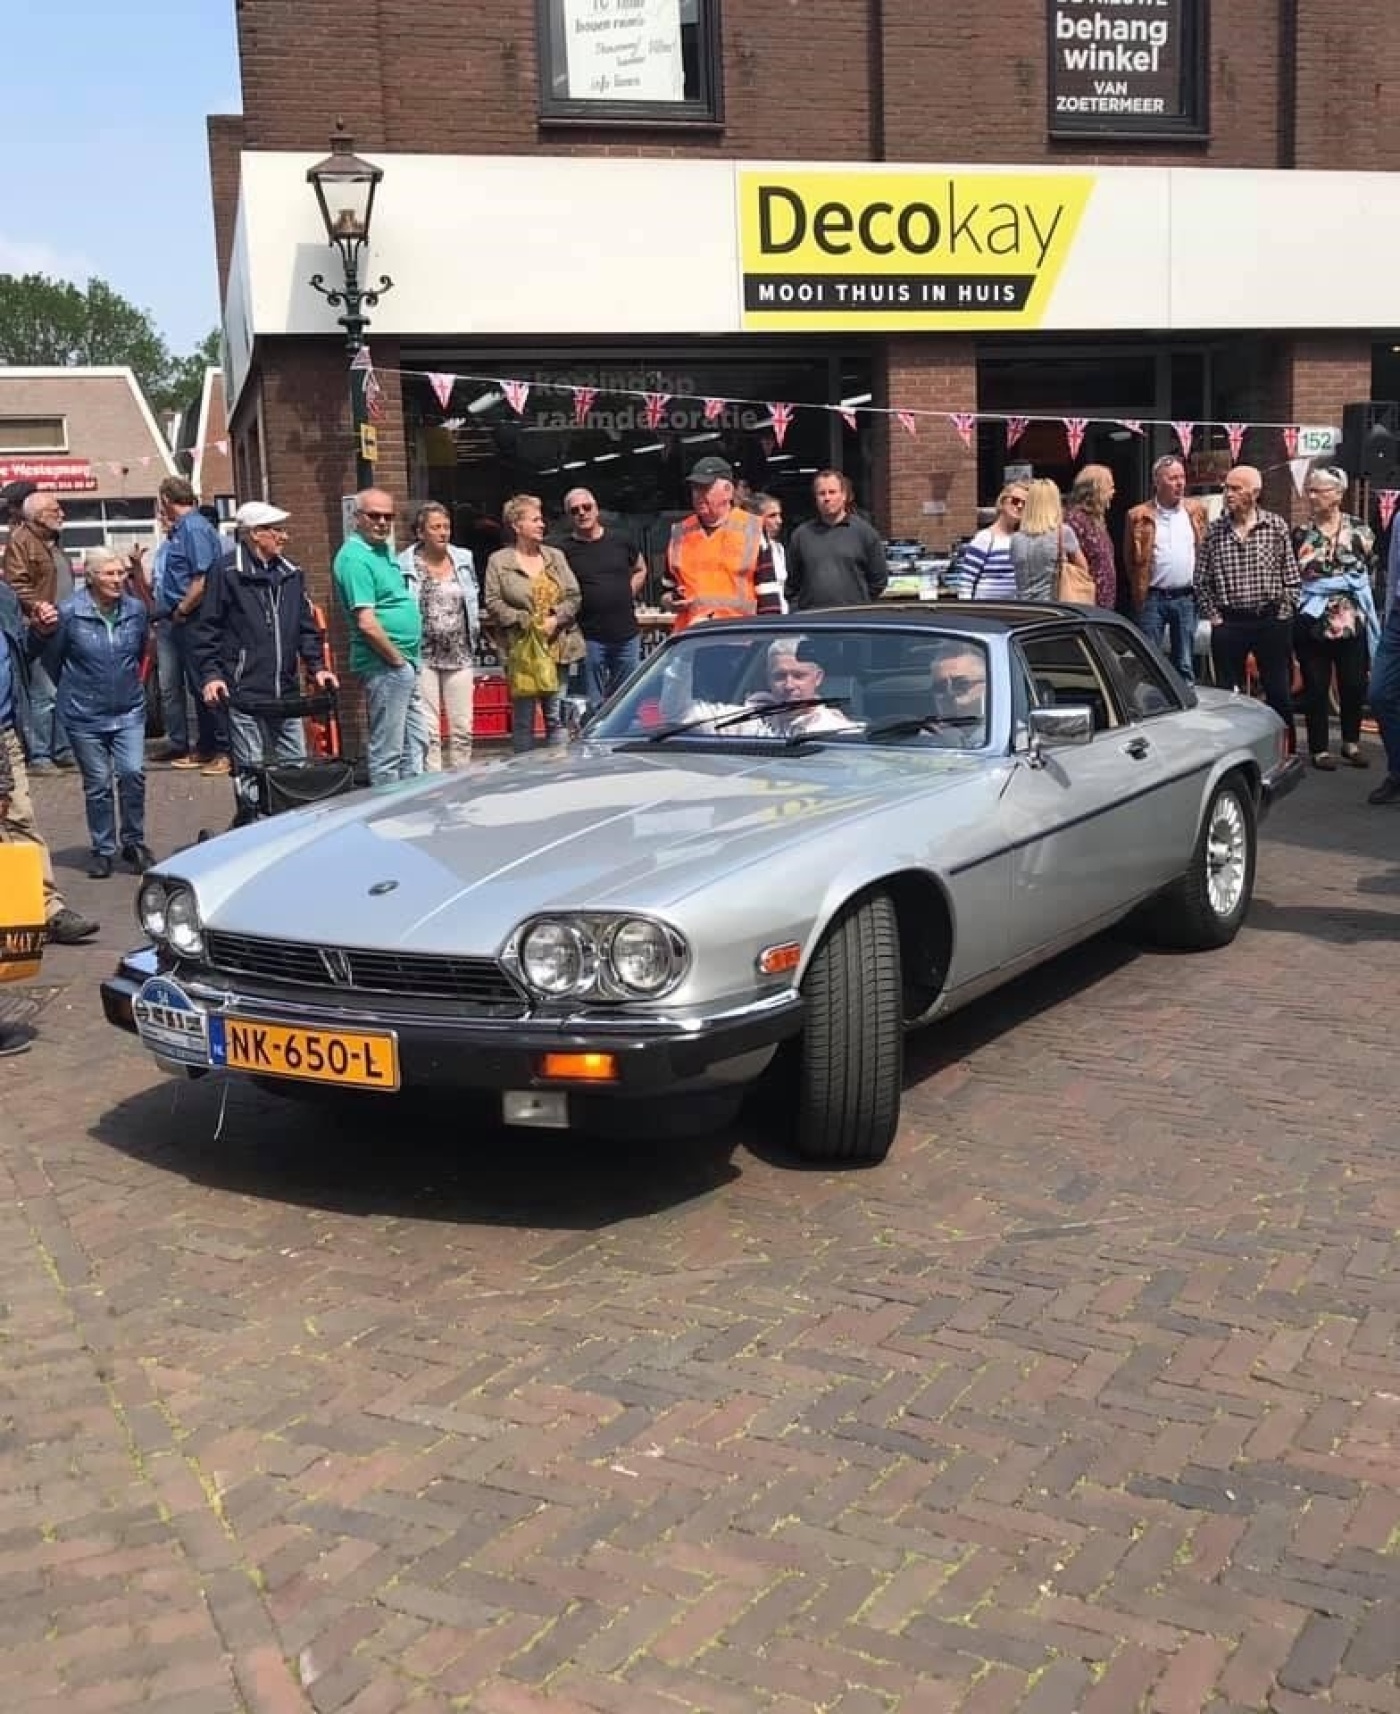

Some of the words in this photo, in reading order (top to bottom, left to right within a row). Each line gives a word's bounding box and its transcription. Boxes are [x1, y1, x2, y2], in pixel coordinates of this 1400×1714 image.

[1057, 11, 1168, 46] behang
[1064, 43, 1158, 71] winkel
[1094, 80, 1127, 95] VAN
[1057, 96, 1164, 112] ZOETERMEER
[758, 180, 1063, 268] Decokay
[759, 283, 823, 301] MOOI
[836, 284, 911, 302] THUIS
[922, 286, 946, 301] IN
[959, 285, 1016, 302] HUIS
[537, 405, 758, 430] raamdecoratie
[1303, 432, 1331, 450] 152
[231, 1025, 383, 1079] NK-650-L
